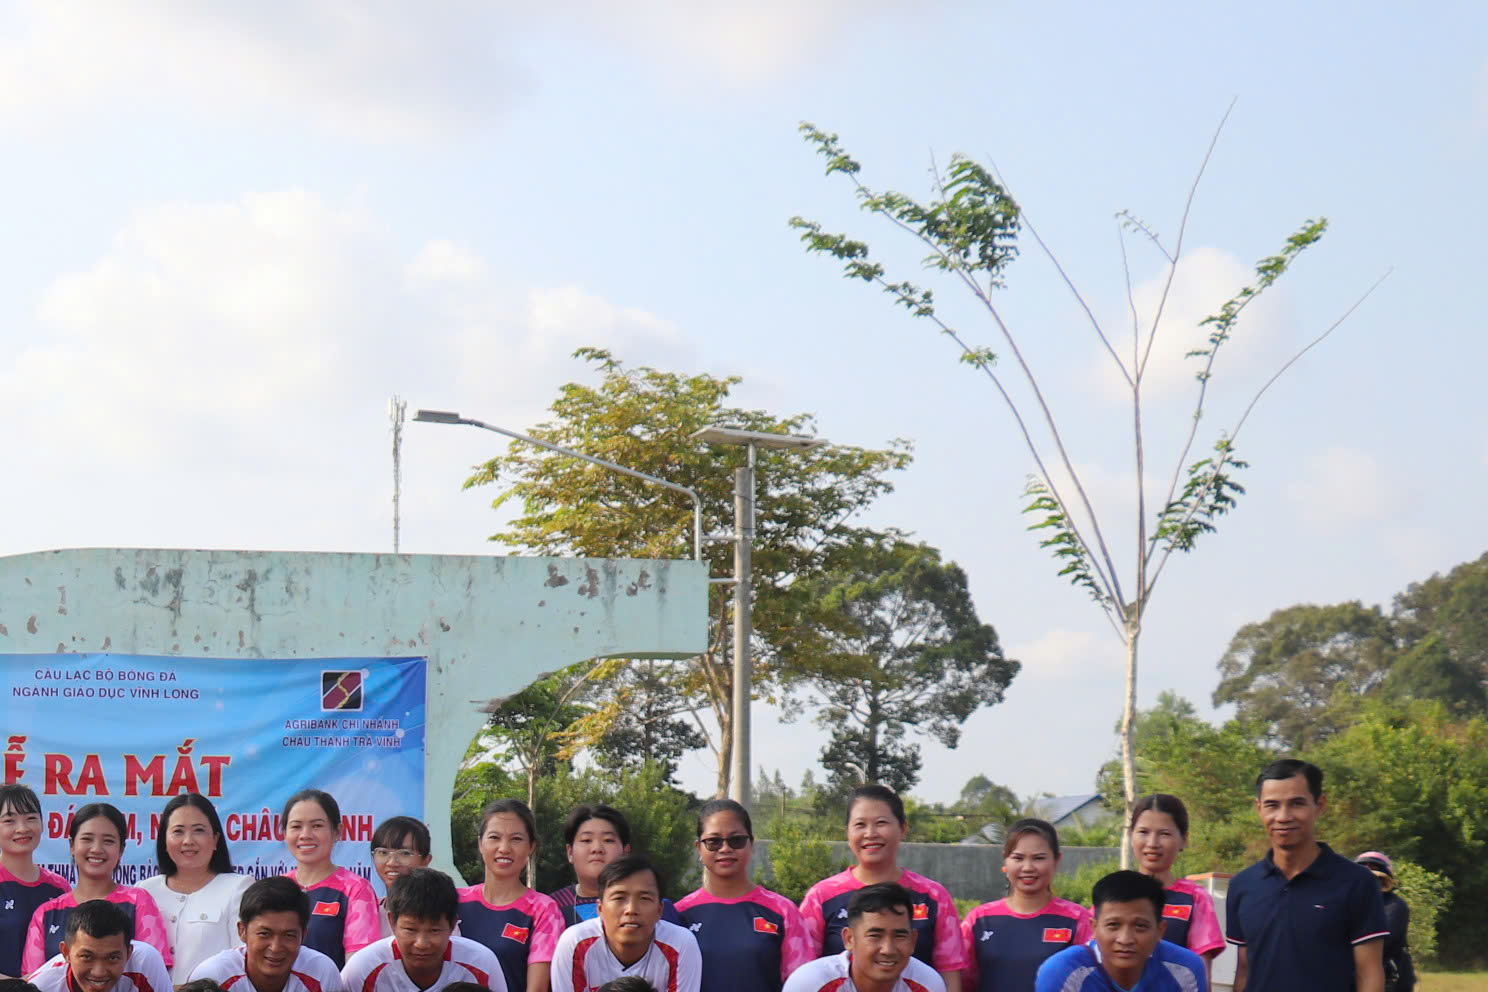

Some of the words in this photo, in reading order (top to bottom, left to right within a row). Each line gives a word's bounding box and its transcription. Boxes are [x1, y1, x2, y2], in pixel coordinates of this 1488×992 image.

[35, 667, 62, 680] CÂU
[65, 670, 92, 682] LẠC
[95, 668, 114, 682] BỘ
[118, 668, 155, 681] BÓNG
[13, 684, 59, 697] NGÀNH
[63, 685, 95, 698] GIÁO
[99, 687, 126, 699] DỤC
[130, 686, 160, 699] VĨNH
[164, 688, 200, 700] LONG
[285, 719, 339, 730] AGRIBANK
[342, 719, 360, 730] CHI
[282, 734, 311, 747] CHÂU
[44, 753, 110, 796] RA
[123, 738, 232, 797] MẮT
